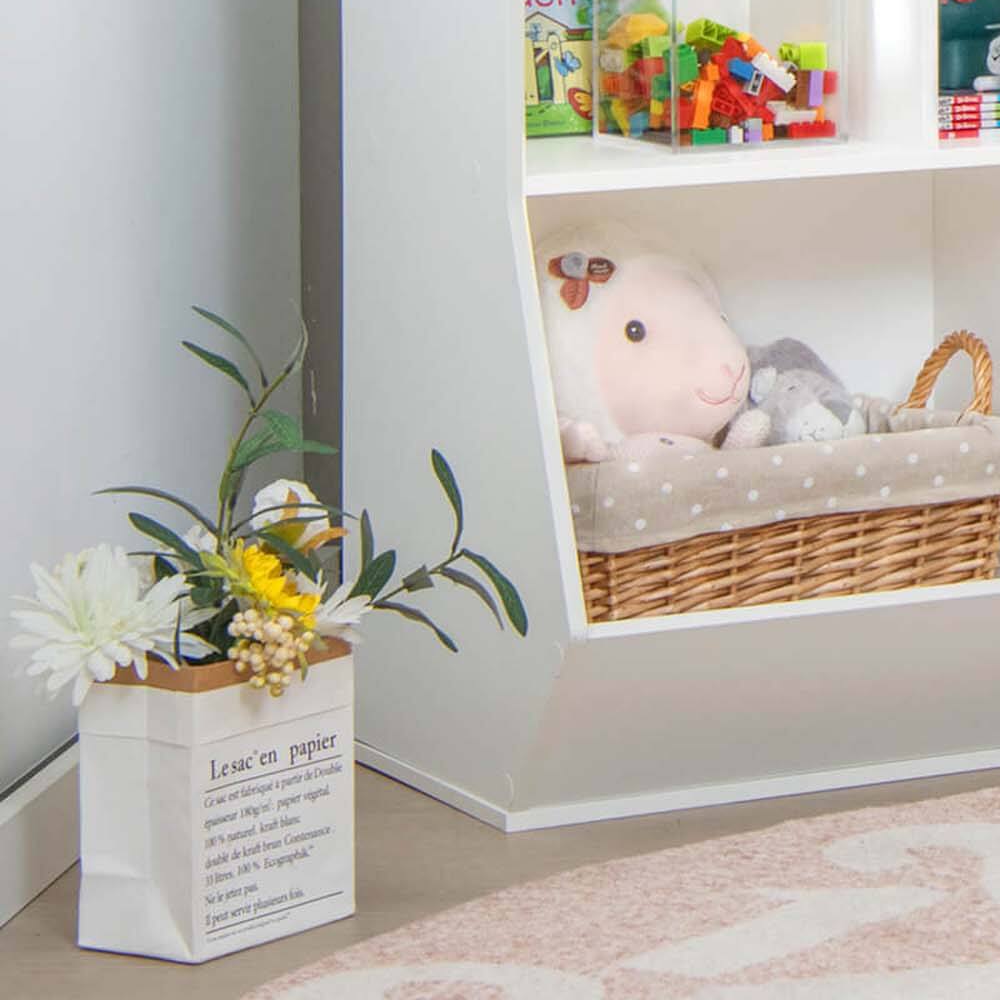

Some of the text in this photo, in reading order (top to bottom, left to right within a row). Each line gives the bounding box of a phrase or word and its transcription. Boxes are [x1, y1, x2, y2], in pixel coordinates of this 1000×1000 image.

[259, 748, 278, 766] en
[289, 733, 338, 765] papier
[277, 794, 302, 811] papier
